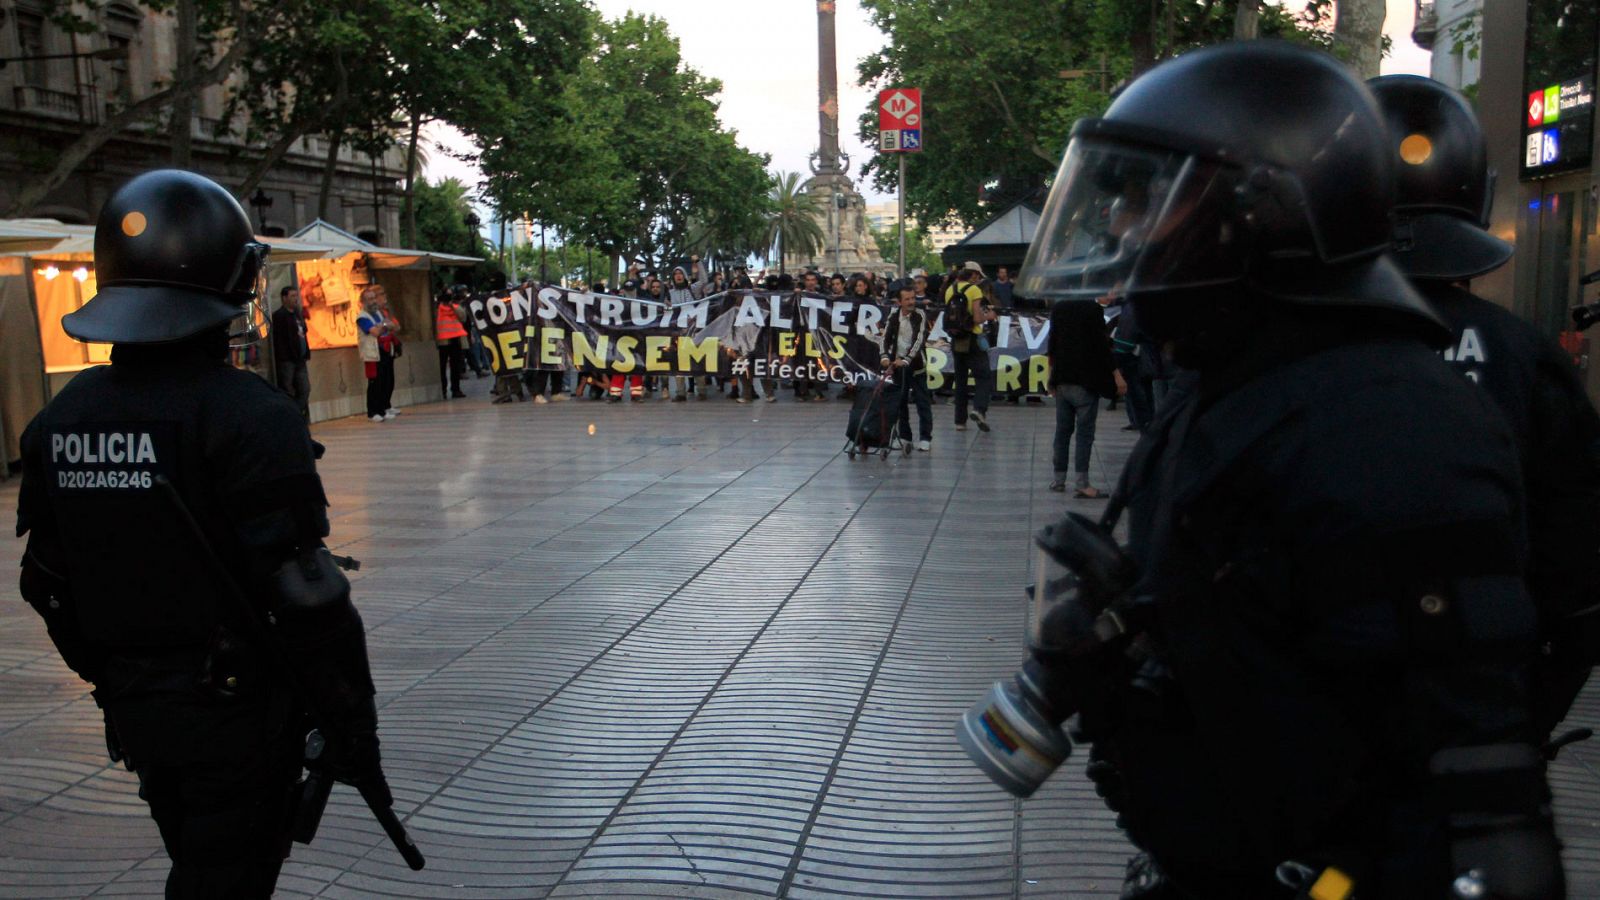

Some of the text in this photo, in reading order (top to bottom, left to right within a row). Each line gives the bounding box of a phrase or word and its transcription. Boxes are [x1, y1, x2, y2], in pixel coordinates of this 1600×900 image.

[891, 99, 906, 112] M
[1544, 94, 1559, 116] L3
[469, 287, 710, 330] CONSTRUIM
[480, 325, 719, 374] DEENSEM
[779, 332, 847, 359] ELS
[51, 432, 157, 463] POLICIA
[58, 471, 152, 488] D202A6246
